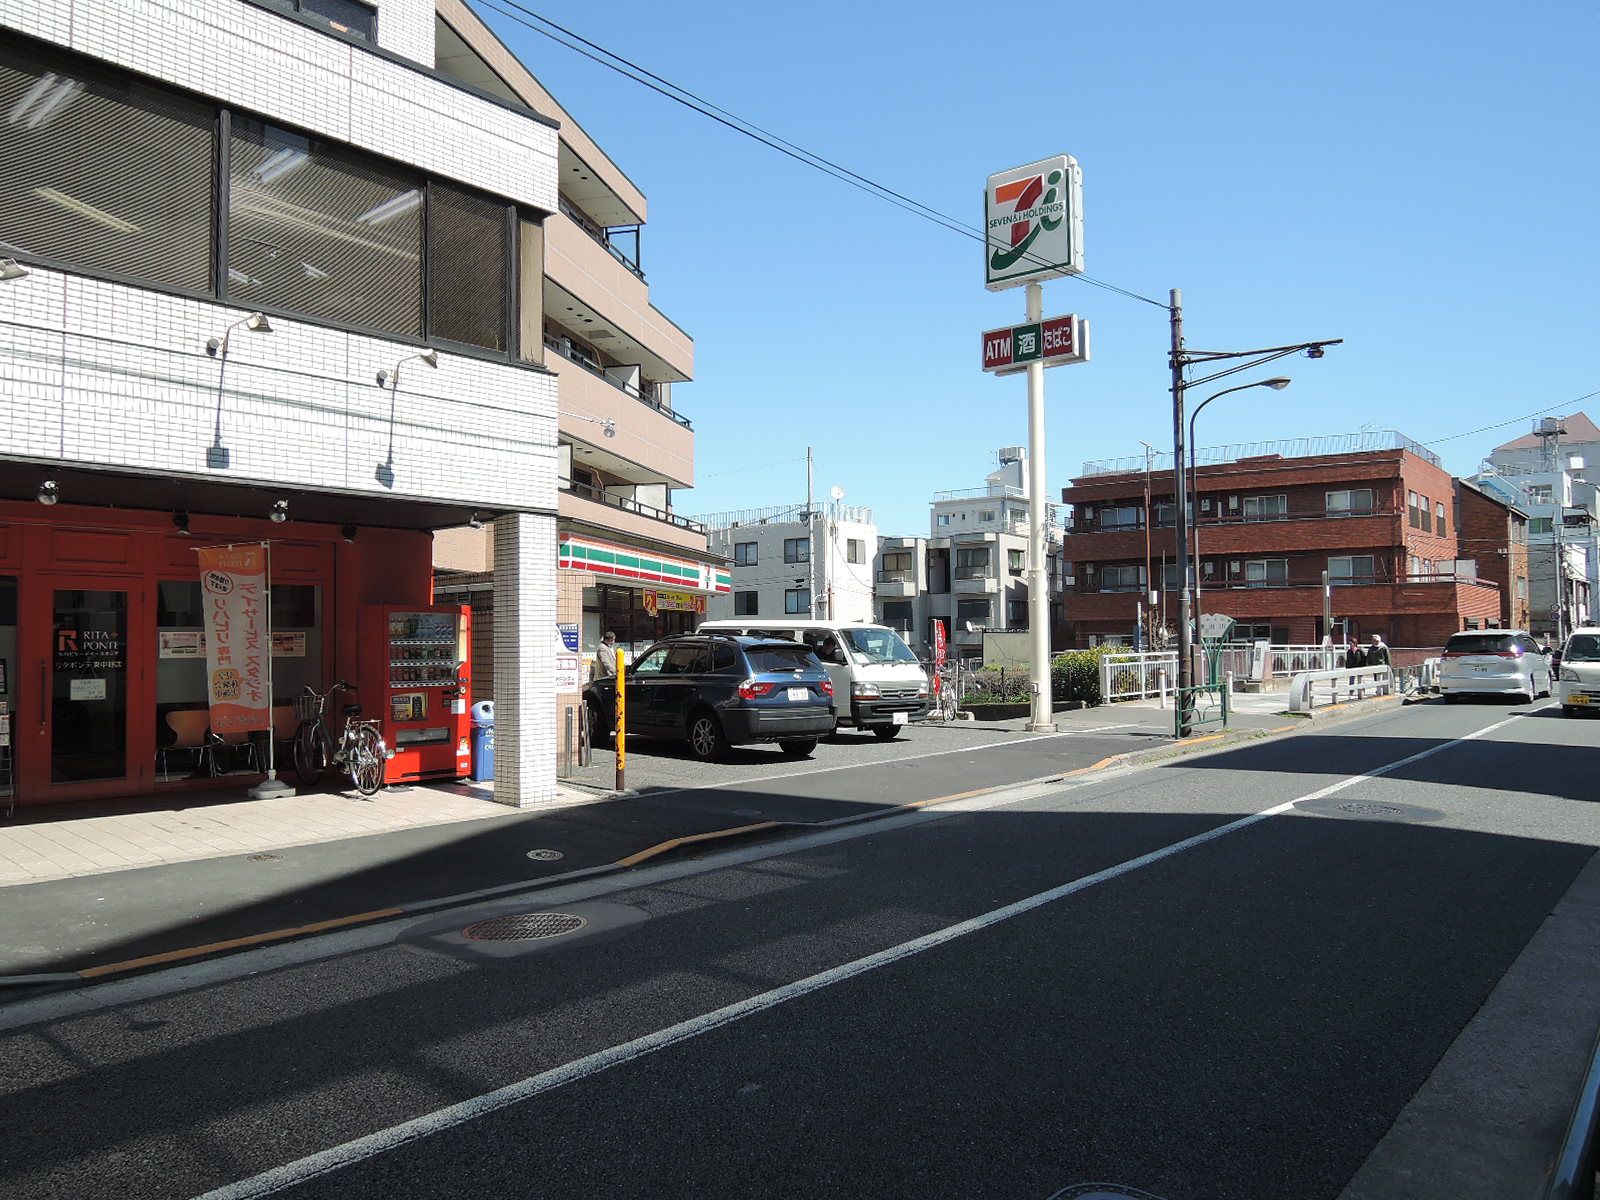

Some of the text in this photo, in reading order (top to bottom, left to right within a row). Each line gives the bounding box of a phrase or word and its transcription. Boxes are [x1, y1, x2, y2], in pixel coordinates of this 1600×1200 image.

[1022, 202, 1064, 219] HOLDINGS
[1018, 332, 1036, 355] 酒
[1043, 326, 1071, 350] たばこ
[985, 339, 1011, 361] ATM
[83, 630, 110, 640] RITA
